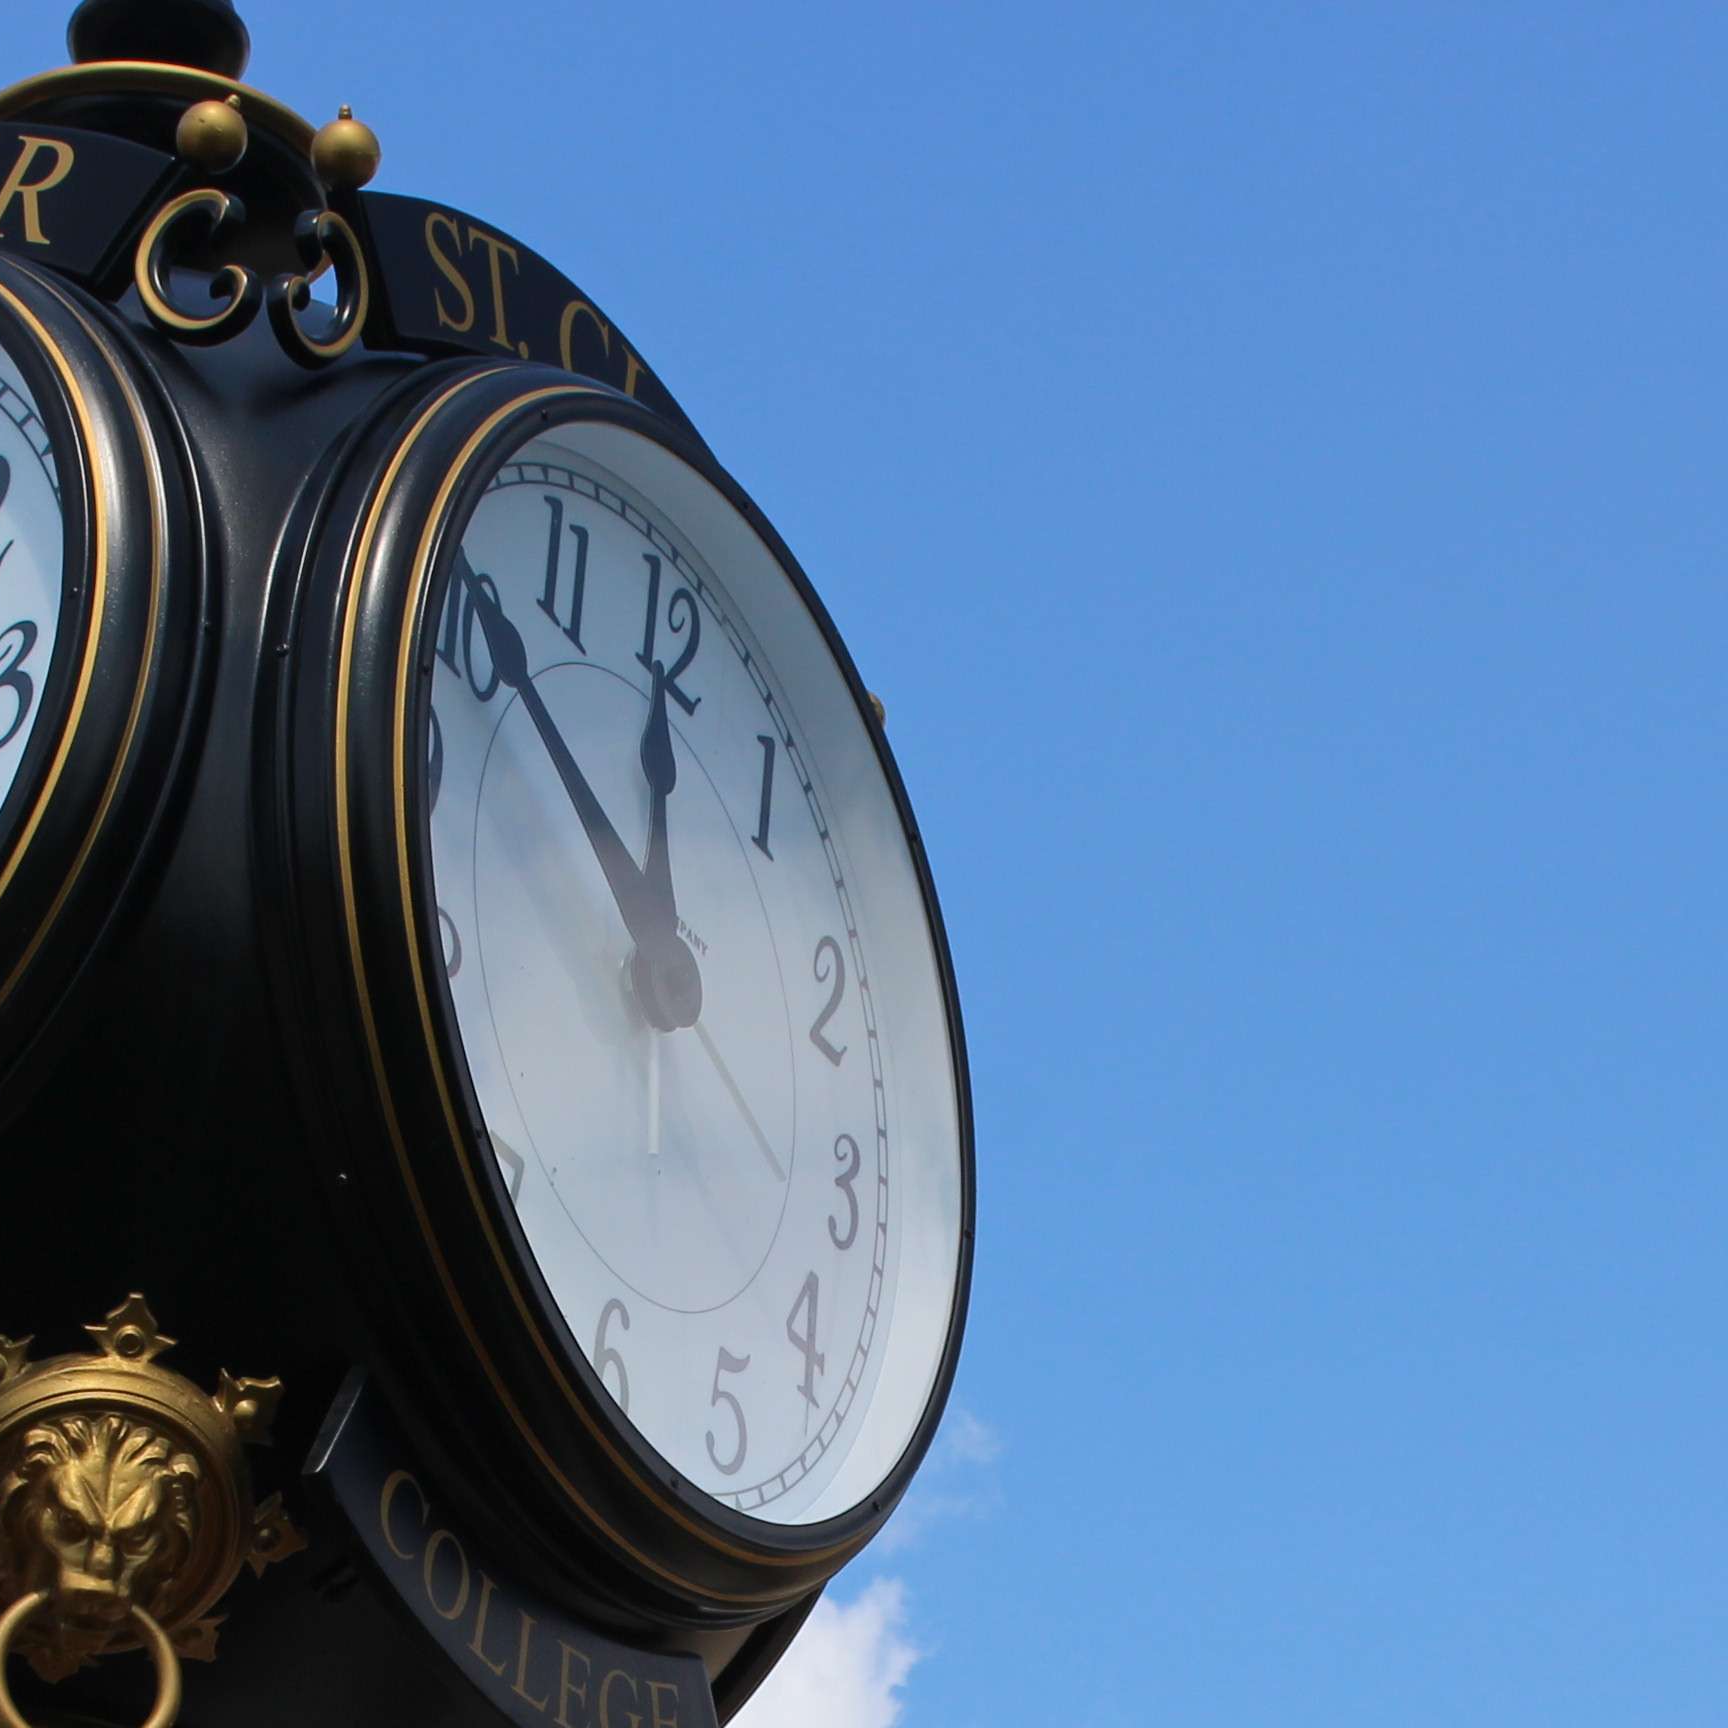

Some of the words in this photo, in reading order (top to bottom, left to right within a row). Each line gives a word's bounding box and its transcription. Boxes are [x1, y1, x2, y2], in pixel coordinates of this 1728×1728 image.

[424, 211, 529, 361] ST.
[536, 494, 589, 656] 11
[635, 552, 702, 717] 12
[751, 734, 776, 861] 1
[809, 935, 848, 1067] 2
[827, 1133, 862, 1250] 3
[785, 1270, 825, 1410] 4
[704, 1346, 751, 1475] 5
